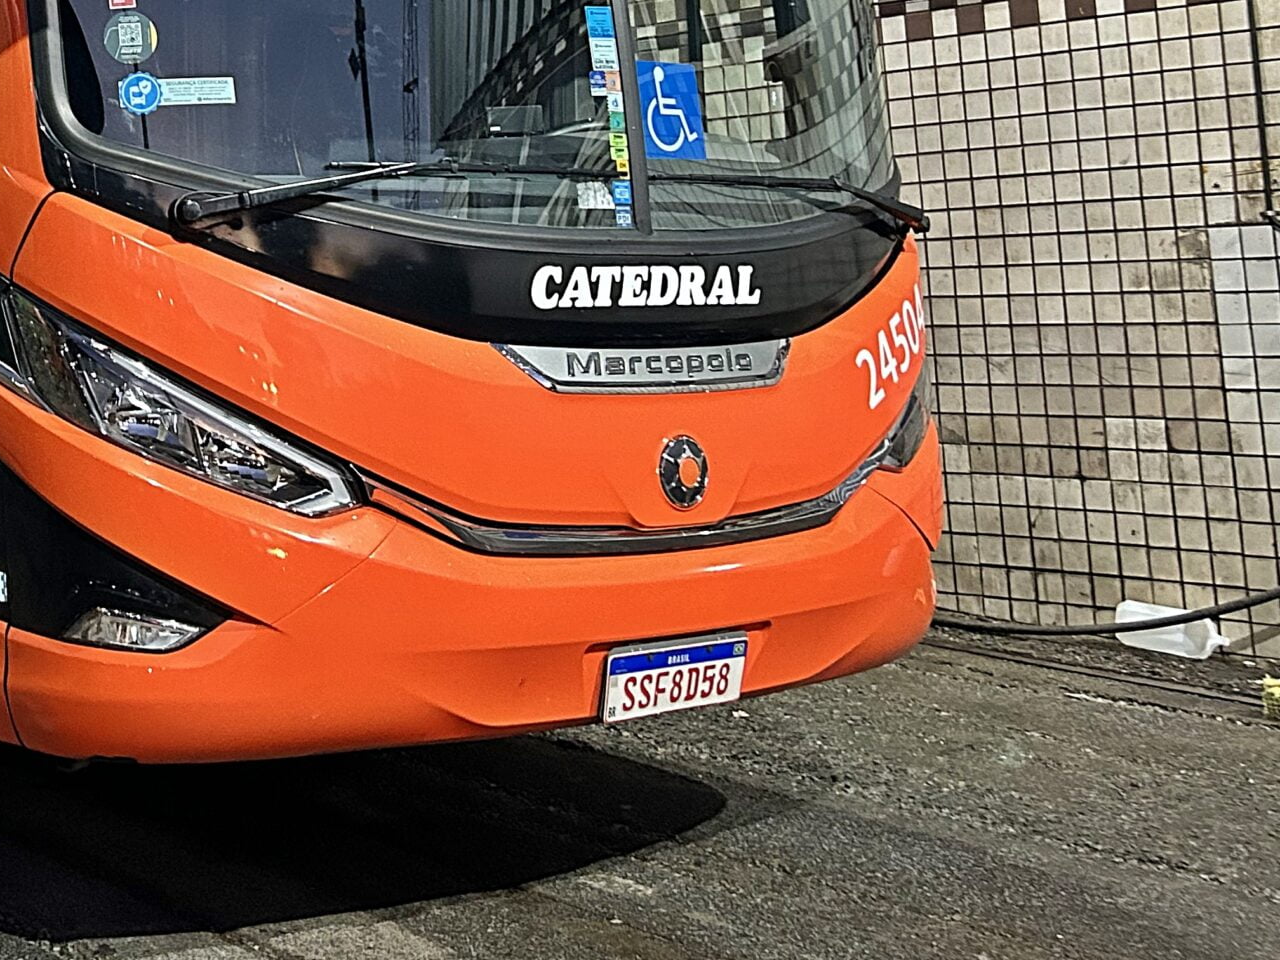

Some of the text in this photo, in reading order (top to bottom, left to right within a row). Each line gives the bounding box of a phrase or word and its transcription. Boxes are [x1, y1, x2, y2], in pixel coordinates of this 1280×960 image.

[530, 265, 761, 310] CATEDRAL
[566, 347, 753, 378] Marcopolo
[855, 283, 926, 410] 24504
[667, 653, 690, 665] BRASIL
[622, 663, 730, 711] SSF8D58
